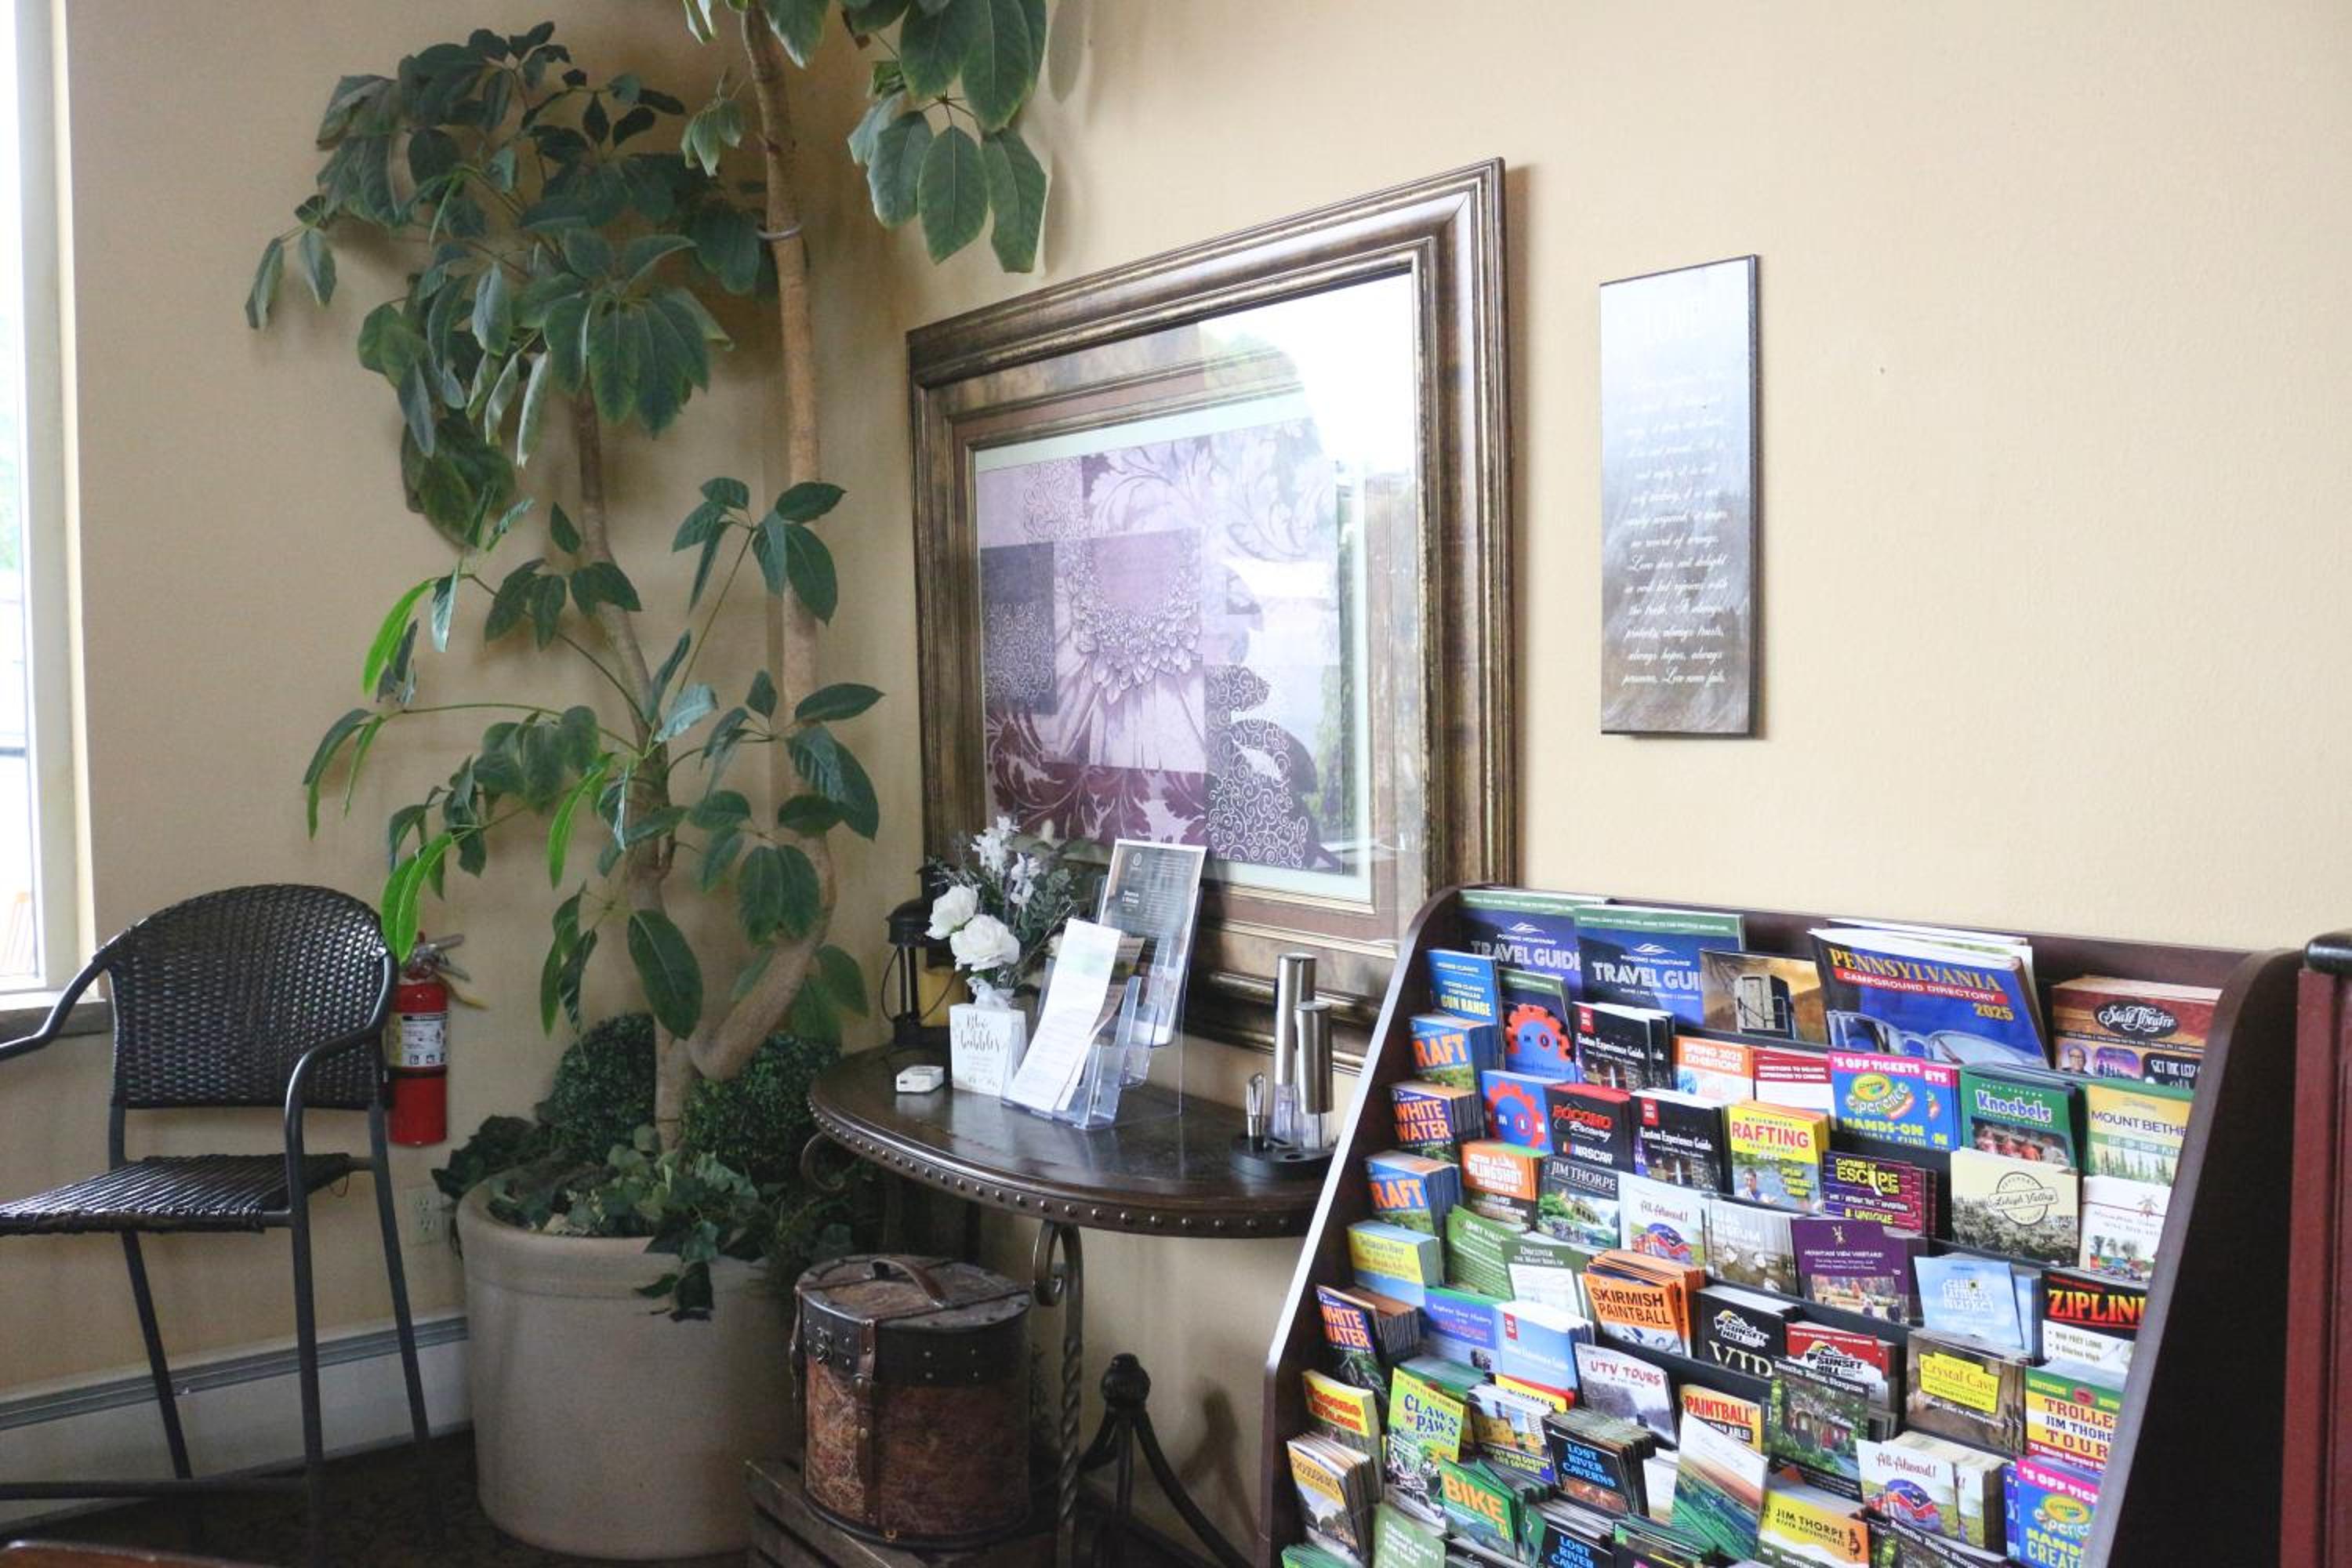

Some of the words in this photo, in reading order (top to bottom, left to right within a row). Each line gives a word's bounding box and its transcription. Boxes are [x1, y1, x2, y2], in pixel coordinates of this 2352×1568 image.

[1471, 940, 1531, 965] TRAVEL
[1592, 961, 1661, 988] TRAVEL
[1663, 969, 1702, 992] GUI
[1828, 947, 2003, 993] PENNSYLVANIA
[1842, 971, 1923, 993] CAMPGROUND
[1926, 985, 1996, 1003] DIRECTORY
[1460, 998, 1492, 1017] RANGE
[1974, 1002, 2015, 1023] 2025
[1412, 1033, 1468, 1067] RAFT
[1595, 1037, 1627, 1055] Experience
[1845, 1057, 1871, 1070] OFF
[1871, 1060, 1920, 1075] TICKETS
[1394, 1100, 1445, 1122] WHITE
[1552, 1104, 1613, 1130] POCONO
[1974, 1089, 2053, 1123] Knoebels
[1395, 1119, 1451, 1142] WATER
[1843, 1116, 1925, 1137] HANDS-ON
[2090, 1109, 2143, 1131] MOUNT
[1661, 1130, 1693, 1148] Experience
[1731, 1121, 1809, 1149] RAFTING
[1575, 1144, 1613, 1165] NASCAR
[1550, 1161, 1569, 1179] JIM
[1570, 1166, 1617, 1191] THORPE
[1369, 1178, 1425, 1210] RAFT
[2024, 1192, 2055, 1205] Valley
[1591, 1287, 1664, 1307] SKIRMISH
[1321, 1305, 1364, 1330] WHITE
[1599, 1301, 1671, 1325] PAINTBALL
[1326, 1325, 1372, 1349] WATER
[1590, 1360, 1619, 1374] UTV
[1623, 1367, 1661, 1386] TOURS
[1816, 1365, 1839, 1376] HILL
[1817, 1356, 1864, 1370] SUNSET
[1921, 1359, 1964, 1384] Crystal
[1965, 1370, 1996, 1394] Cave
[1404, 1393, 1458, 1428] CLAWS
[1685, 1395, 1752, 1426] PAINTBALL
[2044, 1397, 2113, 1430] TROLLE
[2045, 1414, 2066, 1430] JIM
[1415, 1414, 1457, 1438] PAWS
[1568, 1443, 1597, 1460] LOST
[2045, 1428, 2108, 1458] TOUR
[1562, 1461, 1616, 1487] CAVERNS
[1568, 1453, 1604, 1473] RIVER
[1875, 1453, 1893, 1468] All
[1894, 1455, 1937, 1478] Aboard!
[2037, 1472, 2067, 1490] OFF
[1443, 1472, 1505, 1525] BIKE
[1776, 1507, 1795, 1522] JIM
[1798, 1514, 1845, 1539] THORPE
[1559, 1535, 1590, 1557] LOST
[2026, 1526, 2082, 1556] HAND
[1558, 1546, 1595, 1568] RIVER
